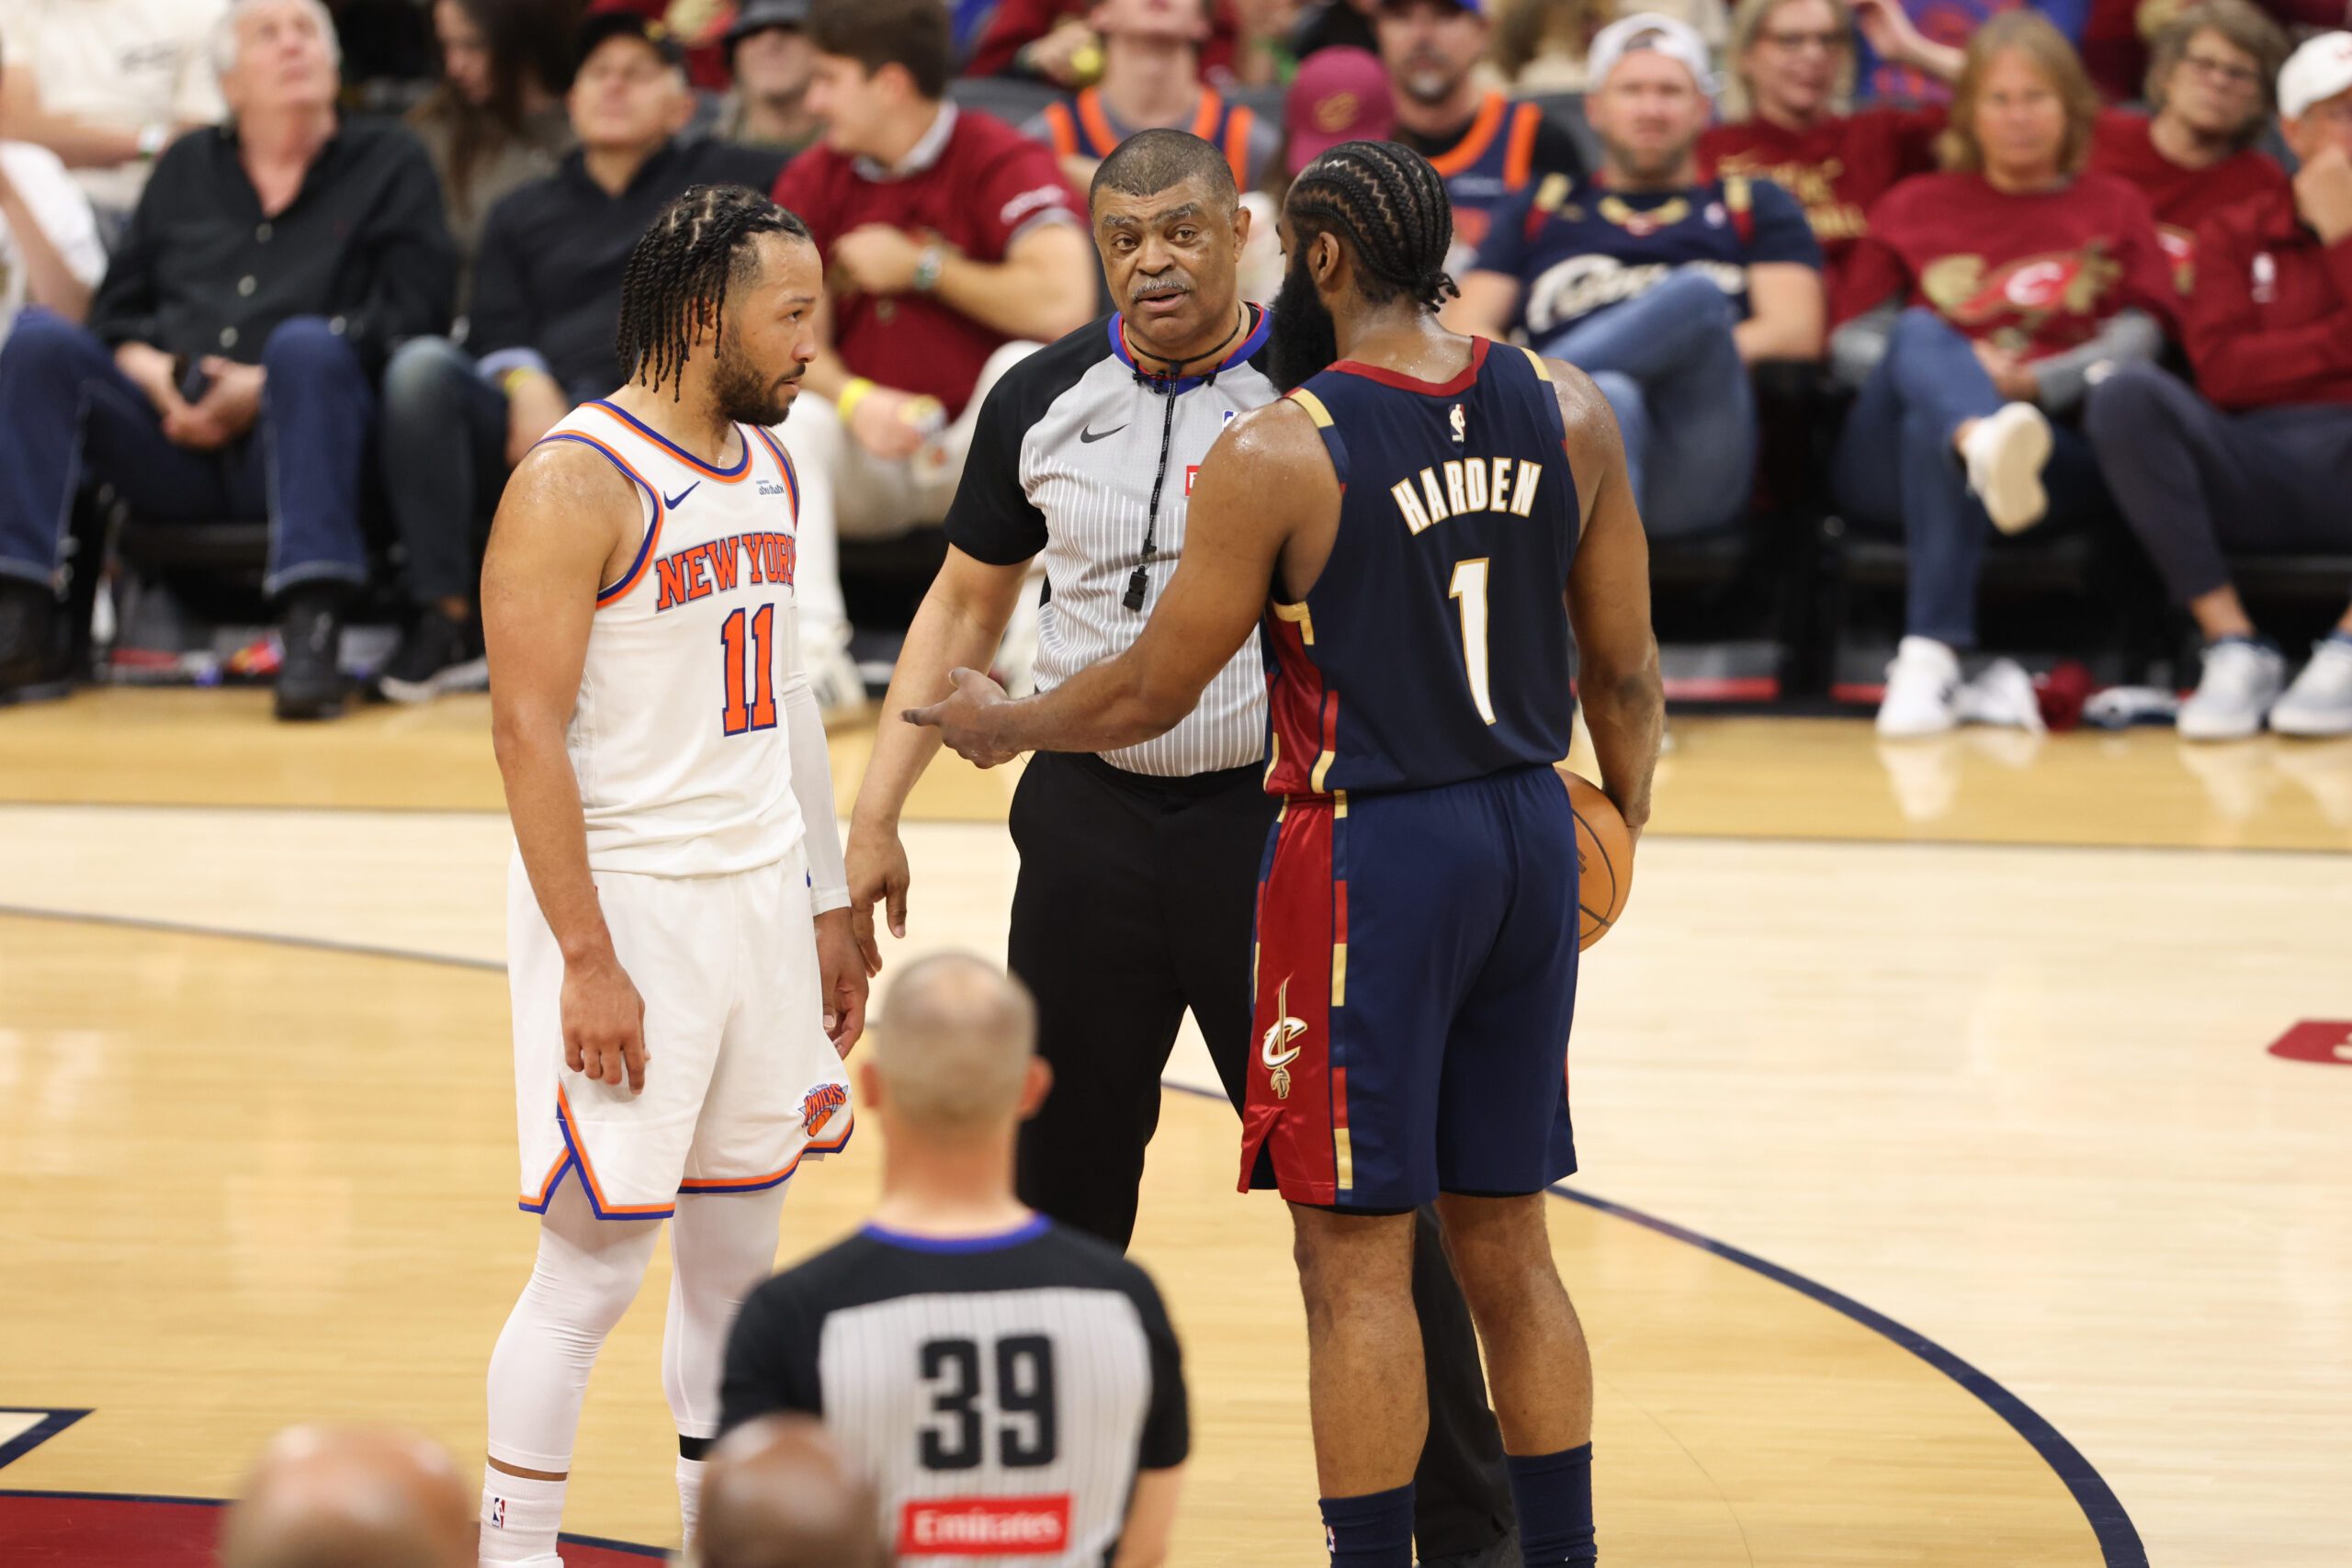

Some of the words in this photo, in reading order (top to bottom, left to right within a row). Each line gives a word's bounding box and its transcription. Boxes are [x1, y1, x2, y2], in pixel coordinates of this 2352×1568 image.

[1390, 457, 1543, 536] HARDEN
[655, 536, 740, 613] NEW
[720, 603, 778, 737] 11
[1449, 558, 1497, 726] 1
[804, 1083, 846, 1126] KNICKS
[921, 1336, 1056, 1470] 39
[913, 1507, 1062, 1546] Emirates
